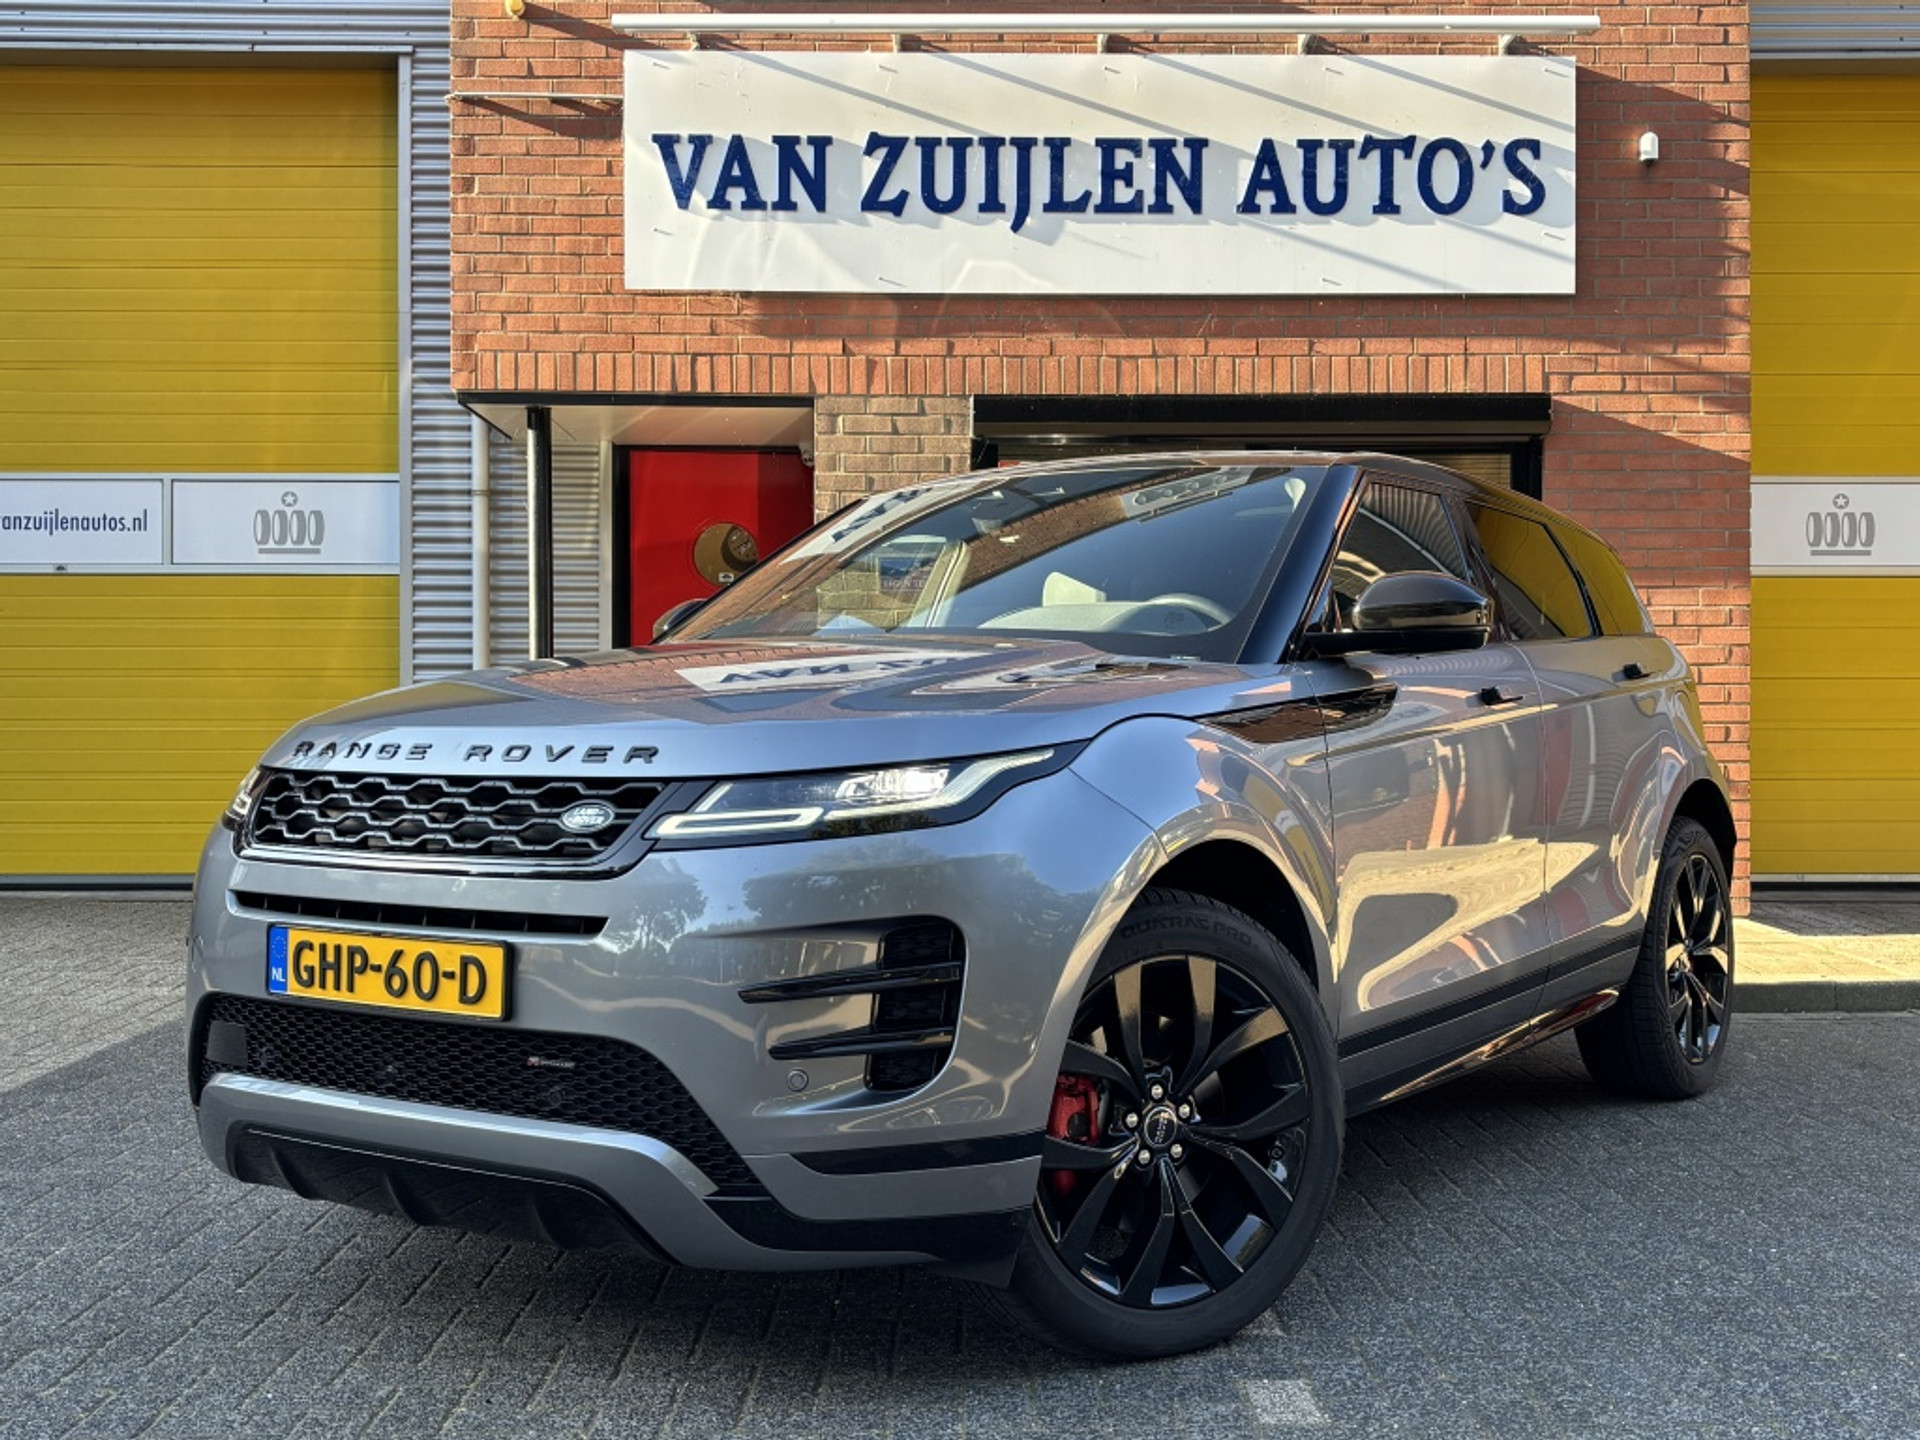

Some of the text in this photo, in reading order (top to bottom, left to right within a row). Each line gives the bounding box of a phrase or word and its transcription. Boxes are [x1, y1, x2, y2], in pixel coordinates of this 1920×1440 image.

[652, 131, 1546, 233] VAN ZUIJLEN AUTO'S
[0, 508, 148, 536] anzuijlenautos.nl
[292, 741, 660, 764] RANGE ROVER
[271, 966, 286, 983] NL
[292, 939, 487, 1005] GHP-60-D
